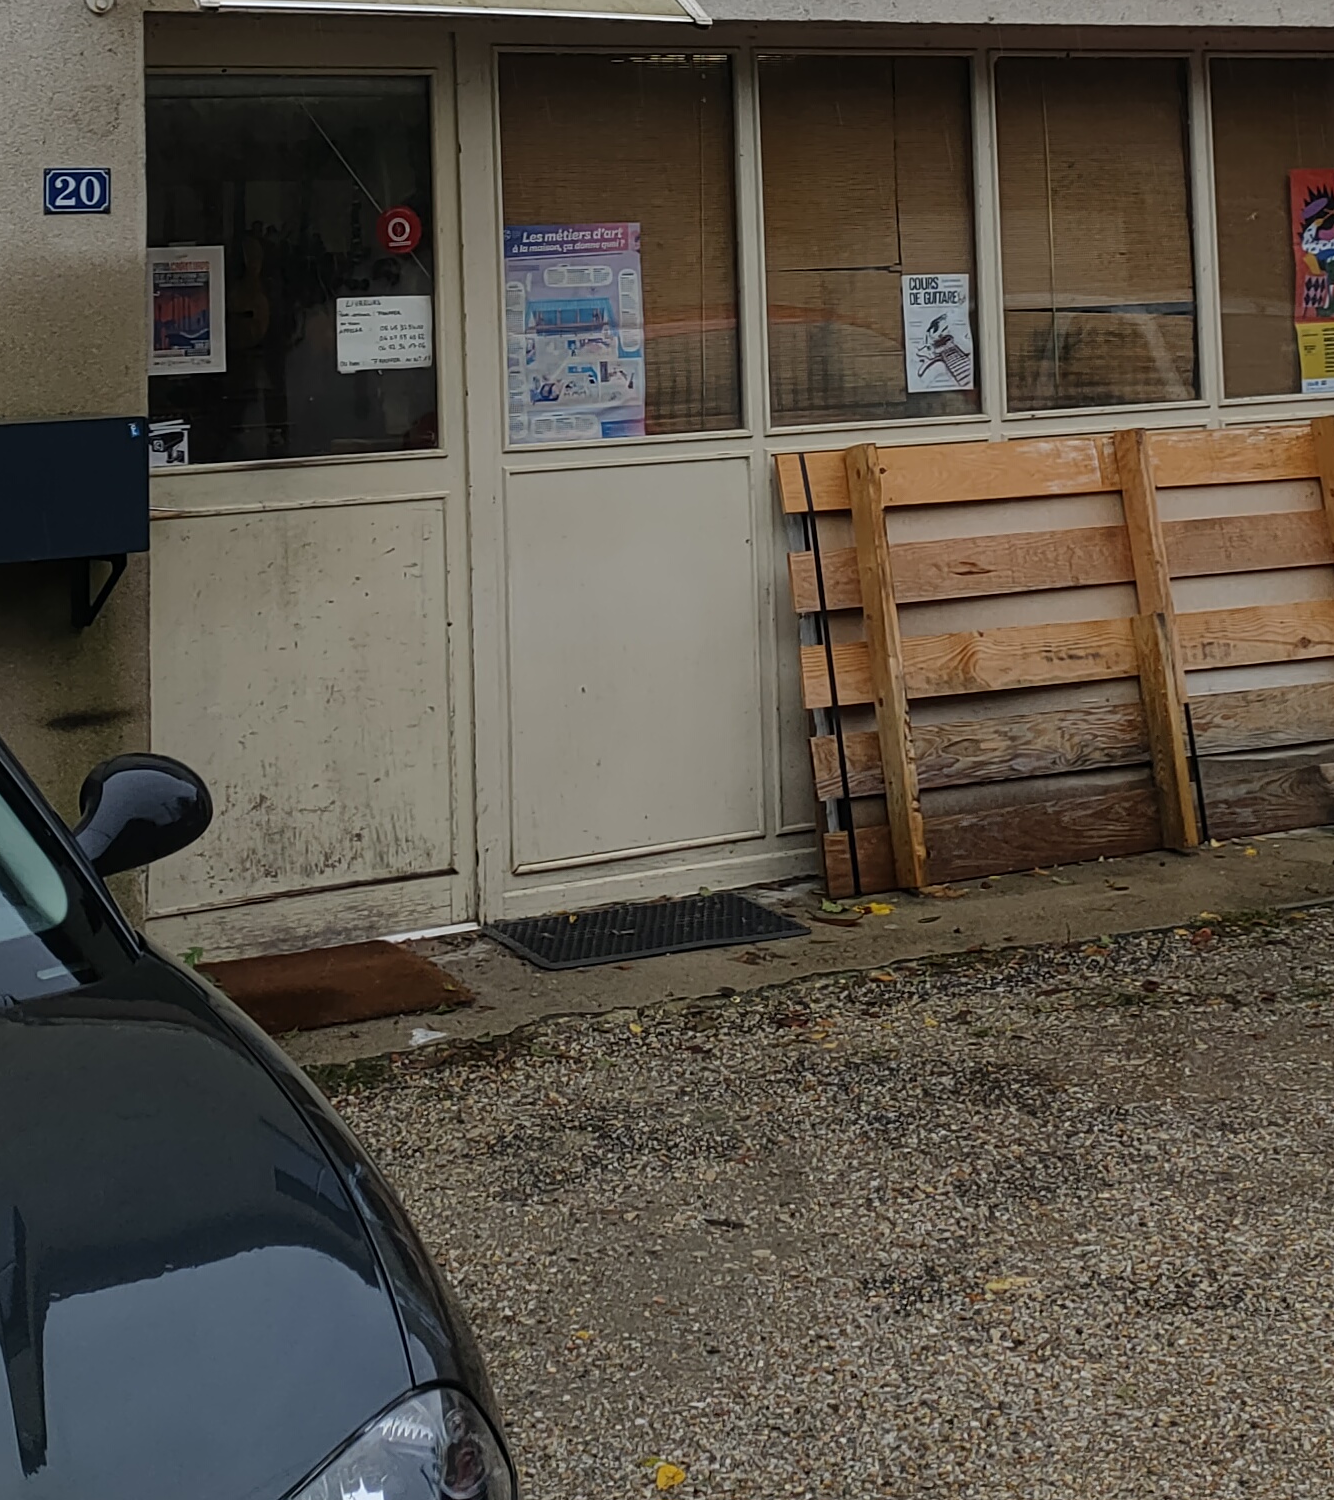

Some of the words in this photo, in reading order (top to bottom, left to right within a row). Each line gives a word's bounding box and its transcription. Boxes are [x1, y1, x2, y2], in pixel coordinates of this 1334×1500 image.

[54, 175, 101, 206] 20
[522, 232, 543, 243] Les
[544, 228, 591, 242] métiers
[593, 227, 624, 239] d'art
[519, 244, 528, 252] la
[909, 276, 939, 291] COURS
[909, 292, 921, 305] DE
[923, 291, 958, 305] GUITARE
